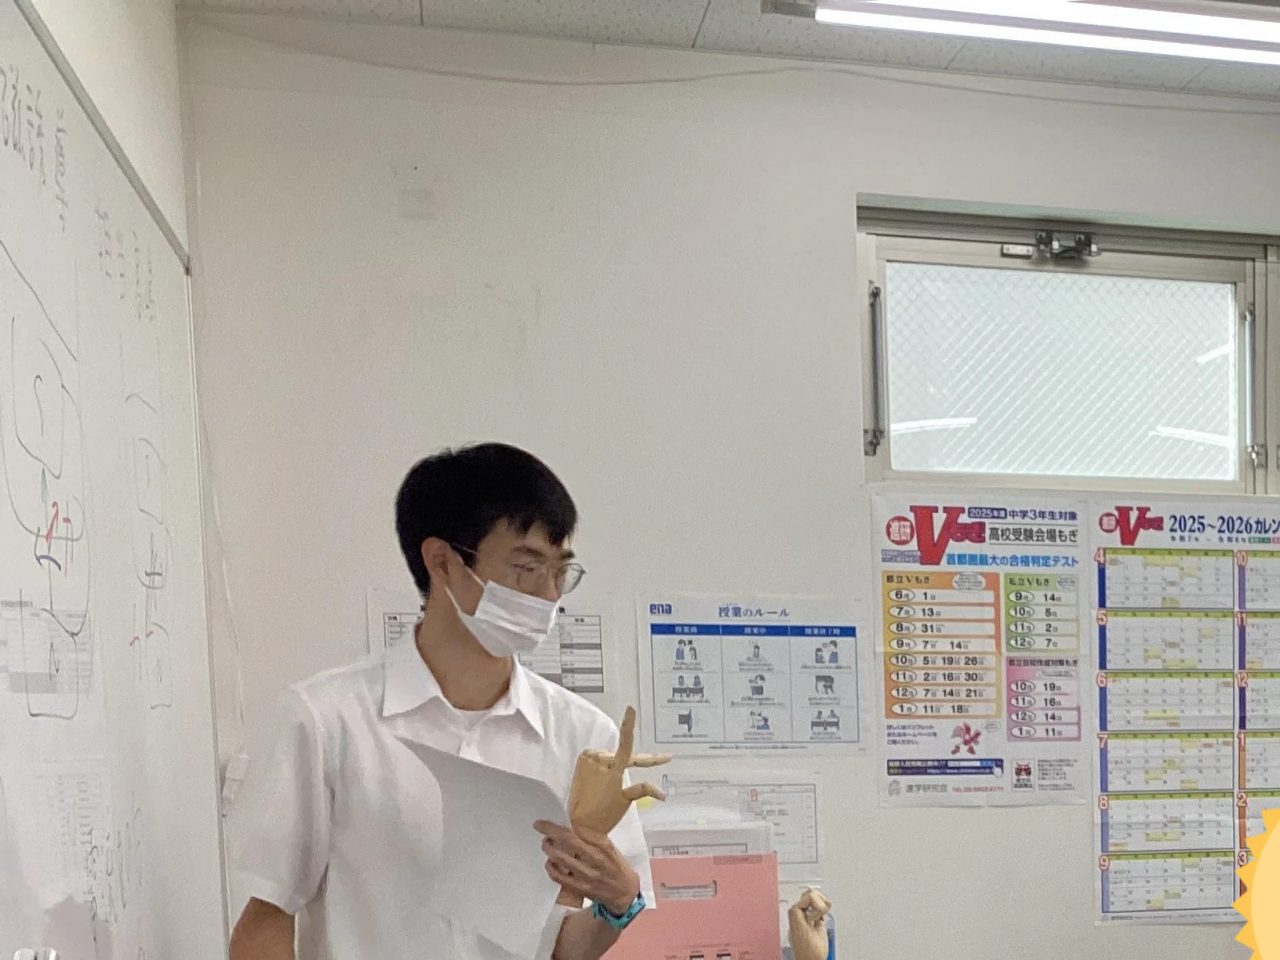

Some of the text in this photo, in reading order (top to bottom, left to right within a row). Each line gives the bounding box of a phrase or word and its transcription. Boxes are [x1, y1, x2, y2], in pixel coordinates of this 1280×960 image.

[1008, 509, 1078, 520] 中学3年生対象
[988, 527, 1079, 543] 高校受験会場もぎ
[946, 553, 1079, 567] 首都圏最大の合格判定テスト
[649, 603, 672, 614] ena
[718, 605, 790, 618] 授業のルール
[1097, 672, 1107, 688] 6
[1236, 672, 1248, 687] 12
[1098, 733, 1109, 748] 7
[1098, 794, 1109, 809] 8
[1237, 793, 1247, 807] 2
[1099, 855, 1110, 870] 9
